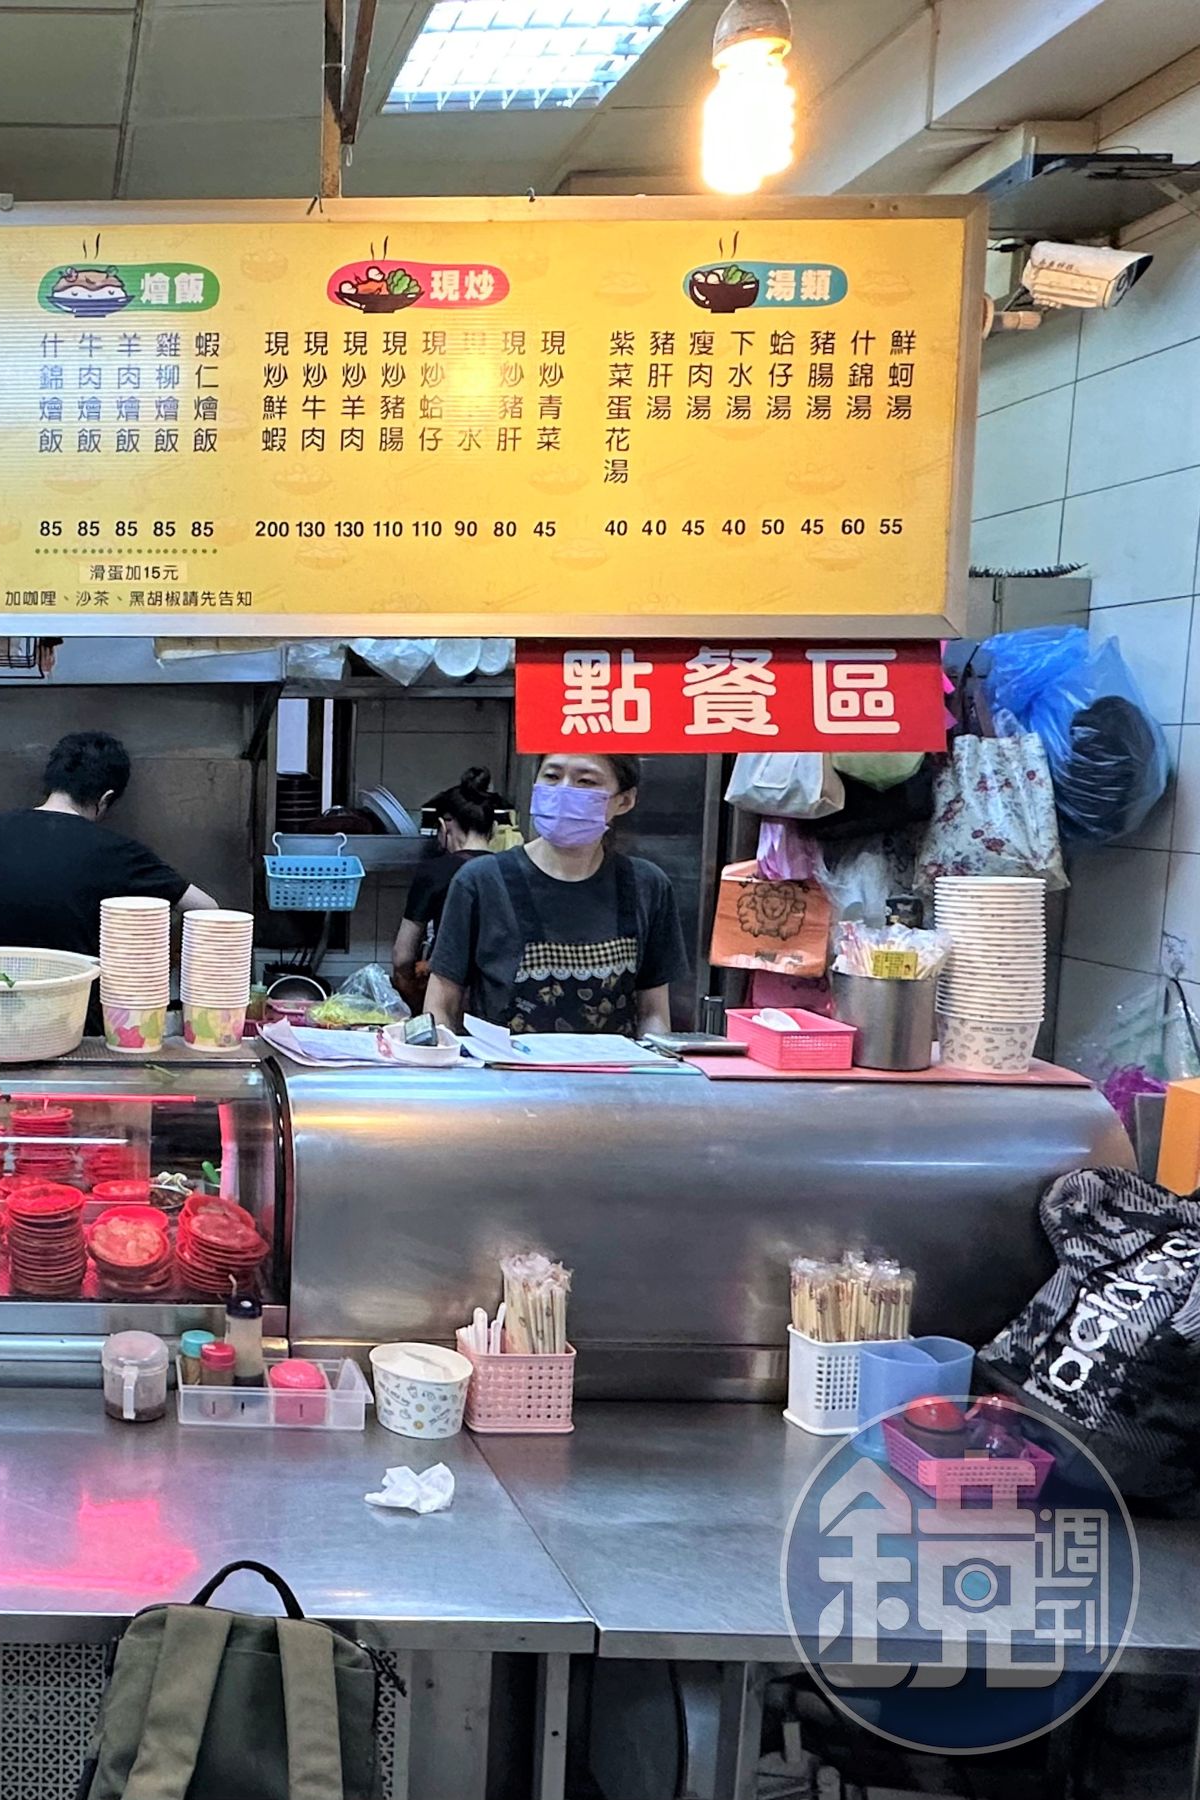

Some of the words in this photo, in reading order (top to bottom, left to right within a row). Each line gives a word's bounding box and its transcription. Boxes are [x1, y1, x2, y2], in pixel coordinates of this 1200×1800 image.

[140, 272, 204, 304] 燴飯
[430, 270, 495, 301] 現炒
[766, 270, 831, 301] 湯類
[39, 332, 64, 453] 什錦燴飯
[76, 332, 103, 453] 牛肉燴飯
[115, 332, 142, 453] 羊肉燴飯
[154, 332, 181, 453] 雞柳燴飯
[193, 332, 220, 453] 蝦仁燴飯
[261, 331, 290, 452] 現炒鮮蝦
[300, 331, 329, 452] 現炒牛肉
[340, 331, 368, 452] 現炒羊肉
[379, 331, 408, 452] 現炒豬腸
[418, 331, 446, 452] 現炒蛤仔
[497, 331, 526, 452] 現炒豬肝
[536, 330, 566, 452] 現炒青菜
[603, 330, 635, 484] 紫菜蛋花湯
[646, 330, 675, 420] 豬肝湯
[686, 330, 715, 420] 瘦肉湯
[726, 330, 756, 420] 下水湯
[766, 330, 795, 420] 蛤仔湯
[806, 330, 836, 420] 豬腸湯
[846, 330, 876, 420] 什錦湯
[886, 330, 917, 420] 鮮蚵湯
[40, 521, 63, 537] 85
[77, 521, 100, 537] 85
[115, 521, 138, 537] 85
[153, 521, 176, 537] 85
[191, 521, 214, 537] 85
[255, 521, 290, 537] 200
[296, 521, 325, 537] 130
[335, 521, 364, 537] 130
[373, 521, 403, 537] 110
[412, 521, 442, 537] 110
[454, 521, 478, 537] 90
[493, 521, 517, 537] 80
[533, 521, 556, 537] 45
[605, 519, 628, 536] 40
[642, 519, 667, 536] 40
[682, 519, 705, 536] 45
[722, 519, 746, 536] 40
[761, 519, 785, 536] 50
[801, 519, 824, 536] 45
[841, 519, 865, 536] 60
[879, 519, 903, 536] 55
[89, 565, 179, 581] 滑蛋加15元
[560, 646, 901, 737] 點餐區
